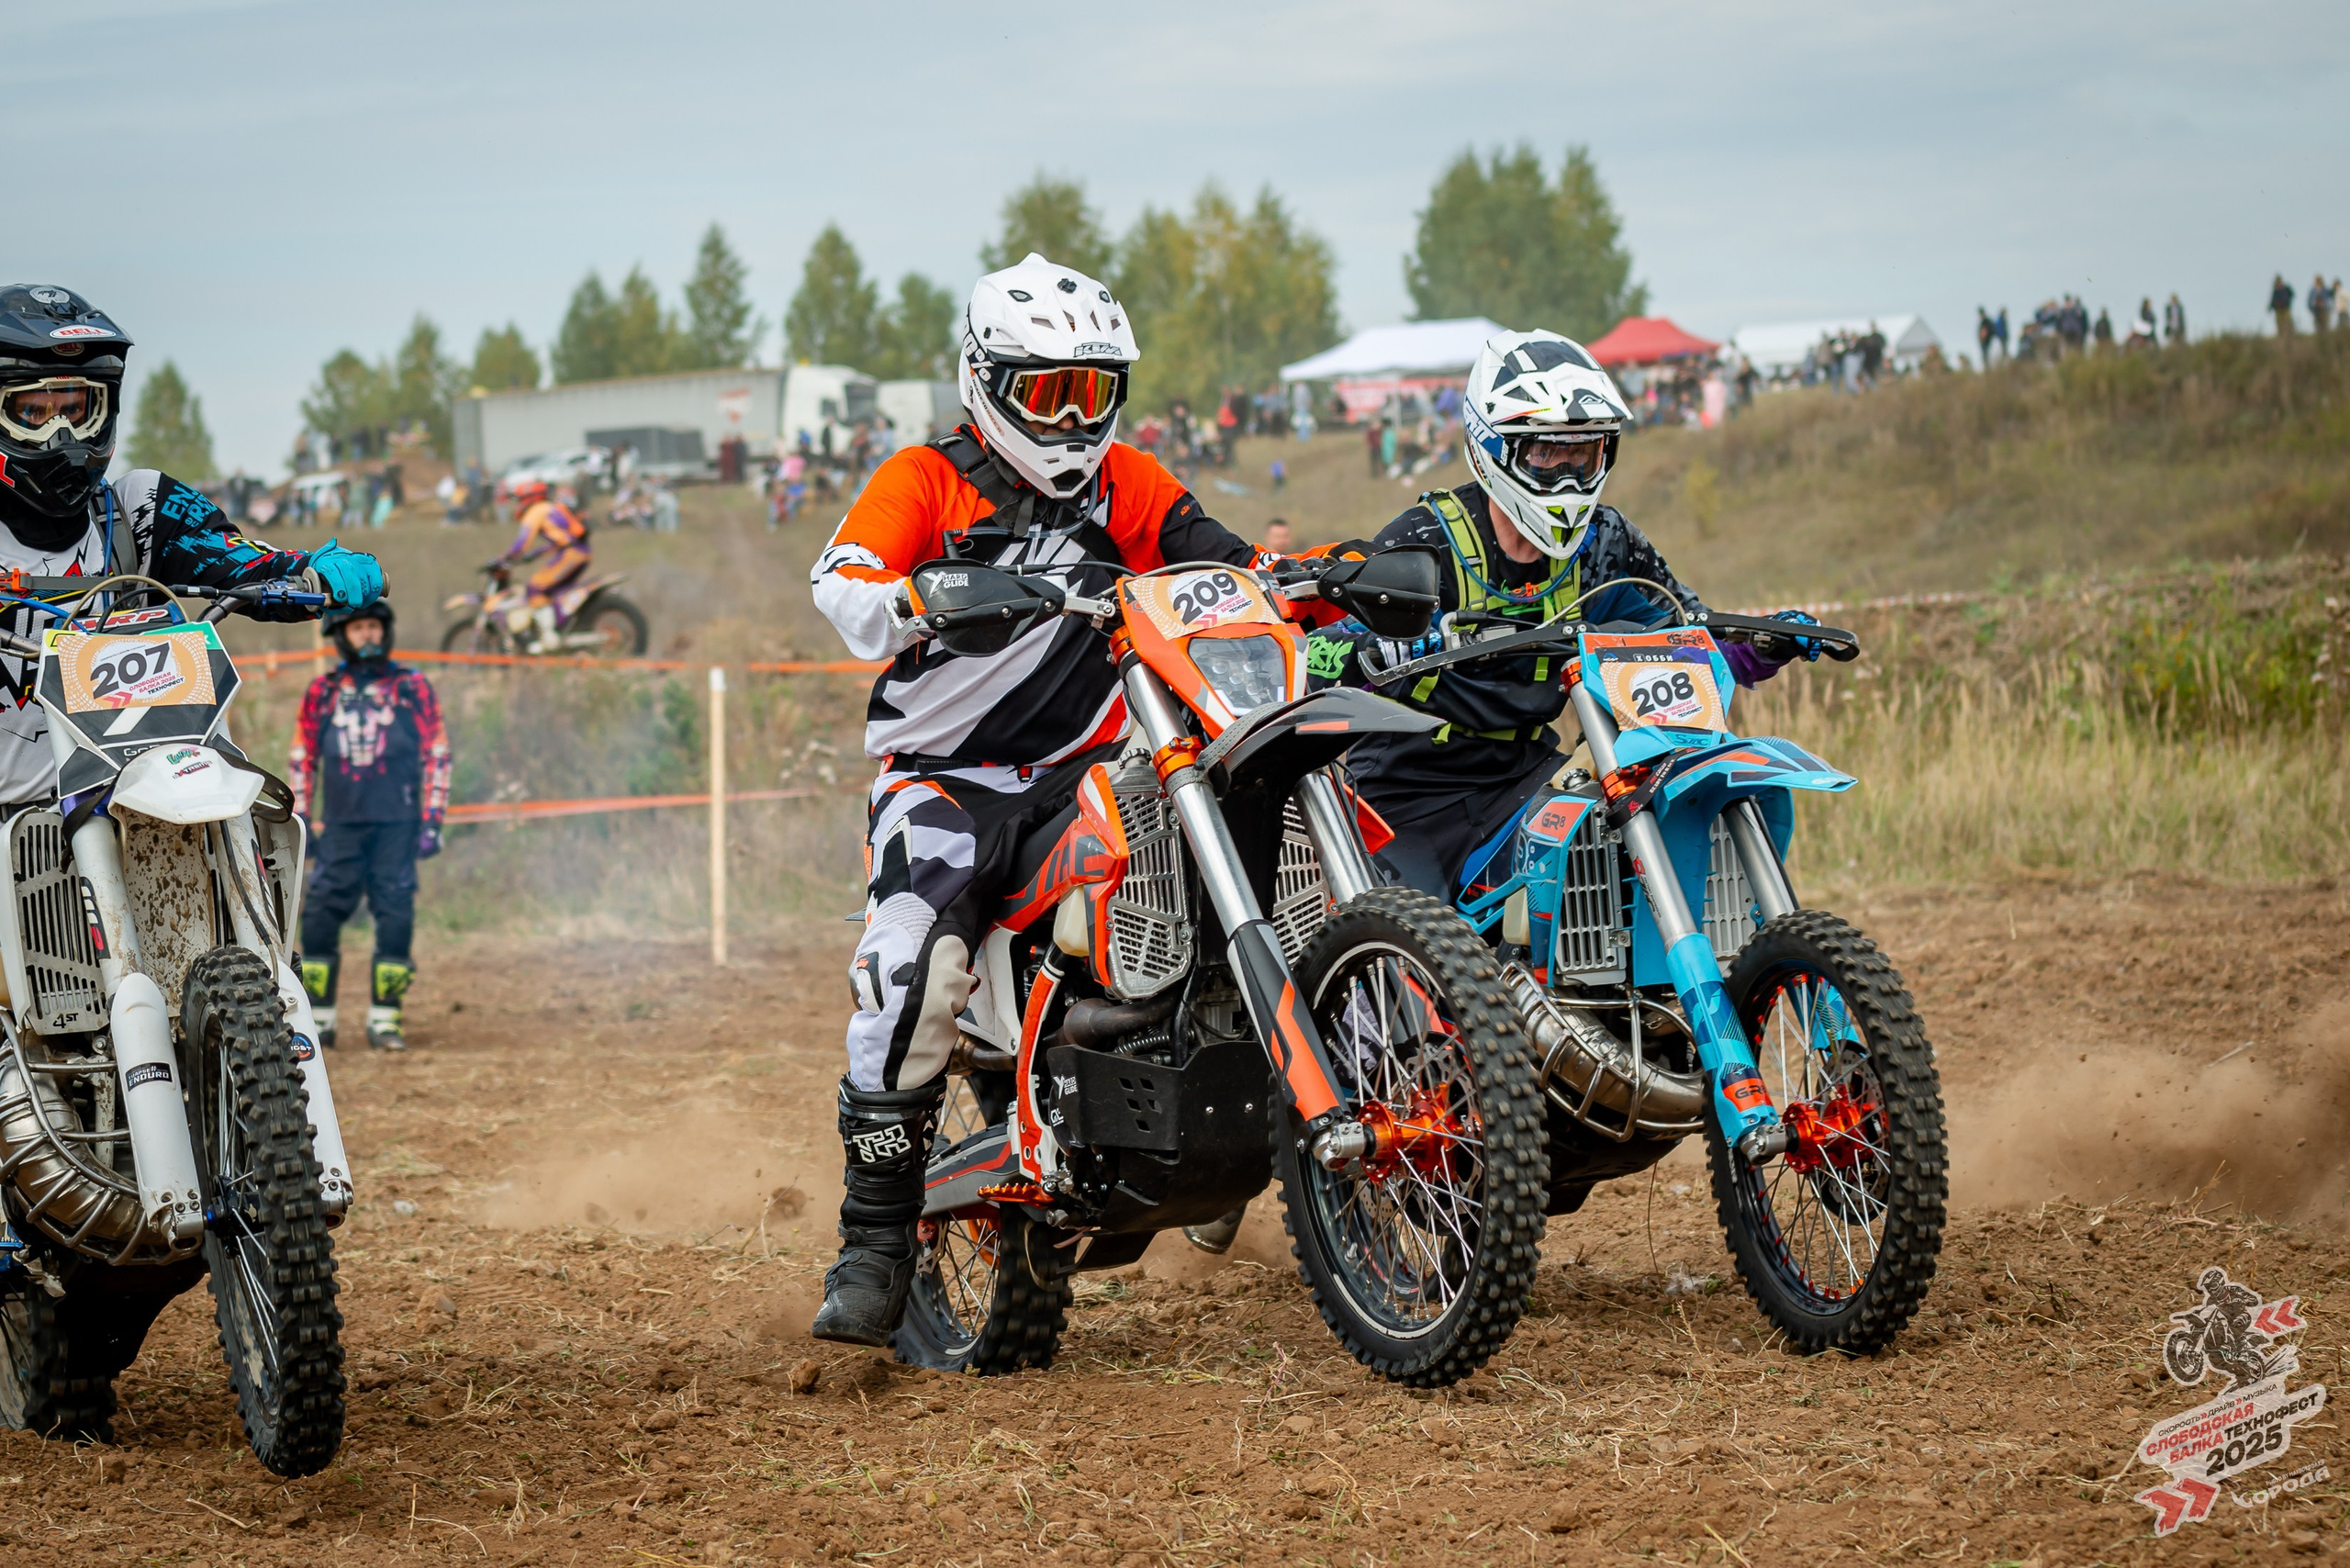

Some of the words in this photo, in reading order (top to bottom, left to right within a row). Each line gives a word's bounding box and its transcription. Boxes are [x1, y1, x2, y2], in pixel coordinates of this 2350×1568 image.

[1073, 342, 1122, 358] KTM
[943, 580, 969, 588] GLIDE
[1173, 573, 1237, 625] 209
[1634, 654, 1673, 662] ХОББИ
[90, 642, 170, 700] 207
[129, 672, 171, 691] СЛОБОДСКАЯ
[139, 681, 161, 693] БАЛКА
[148, 678, 185, 695] ТЕХНОФЕСТ
[1631, 672, 1695, 718] 208
[1542, 812, 1566, 830] GR8
[129, 1070, 169, 1087] ENDURO
